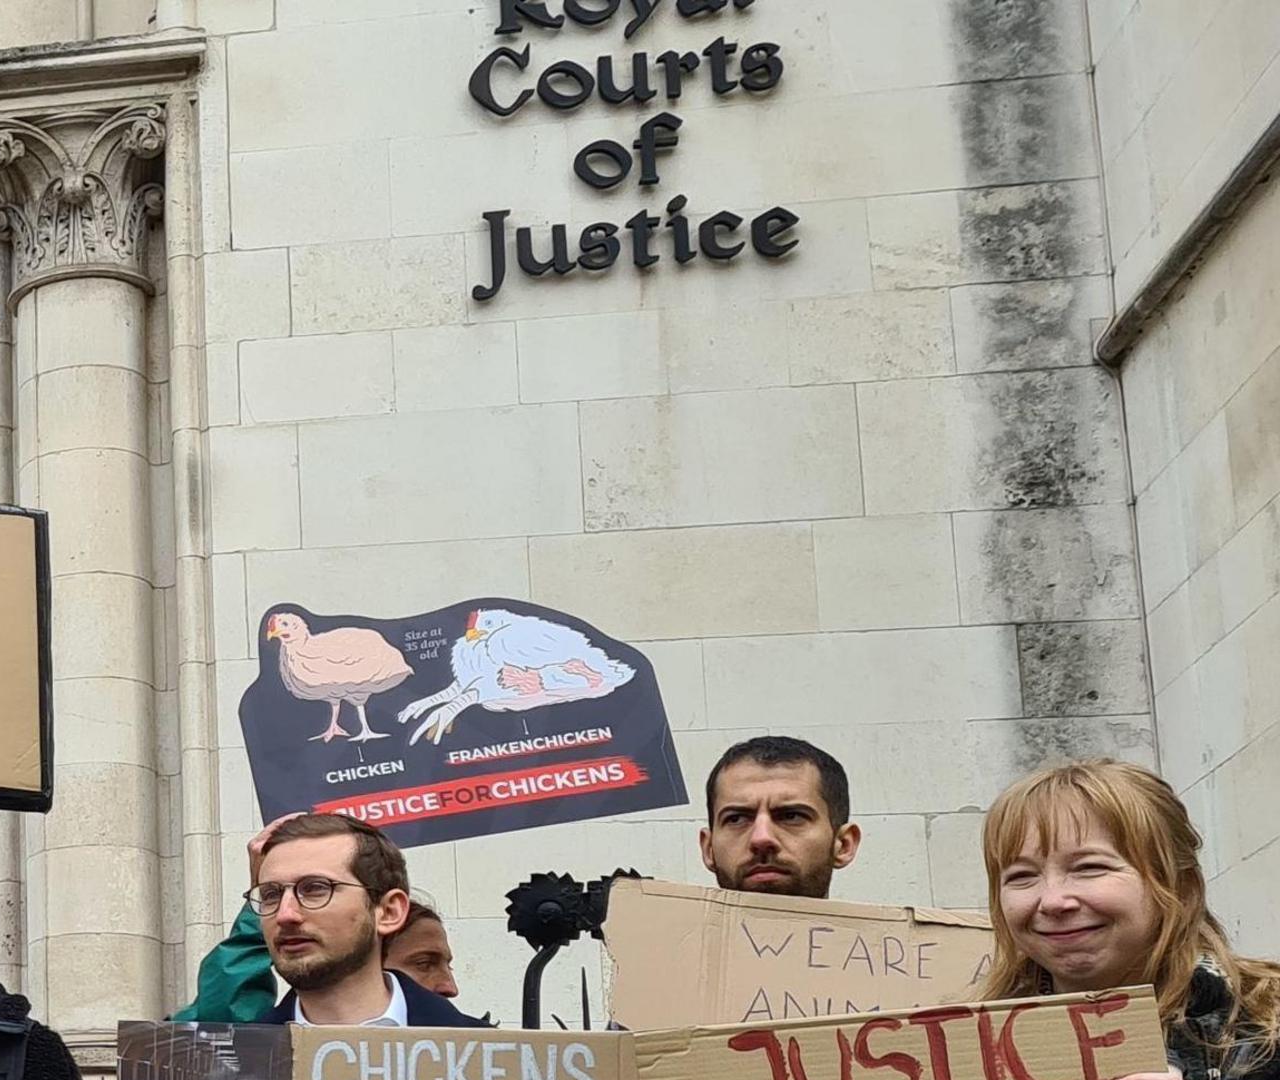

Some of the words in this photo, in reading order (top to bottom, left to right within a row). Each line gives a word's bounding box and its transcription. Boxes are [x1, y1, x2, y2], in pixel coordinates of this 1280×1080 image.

[468, 36, 784, 117] Courts
[573, 111, 684, 190] of
[471, 194, 800, 301] Justice
[404, 630, 428, 641] Size
[419, 647, 438, 660] old
[420, 638, 447, 650] days
[325, 760, 405, 785] CHICKEN
[449, 726, 613, 764] FRANKENCHICKEN
[332, 762, 625, 821] USTICEFORCHICKENS
